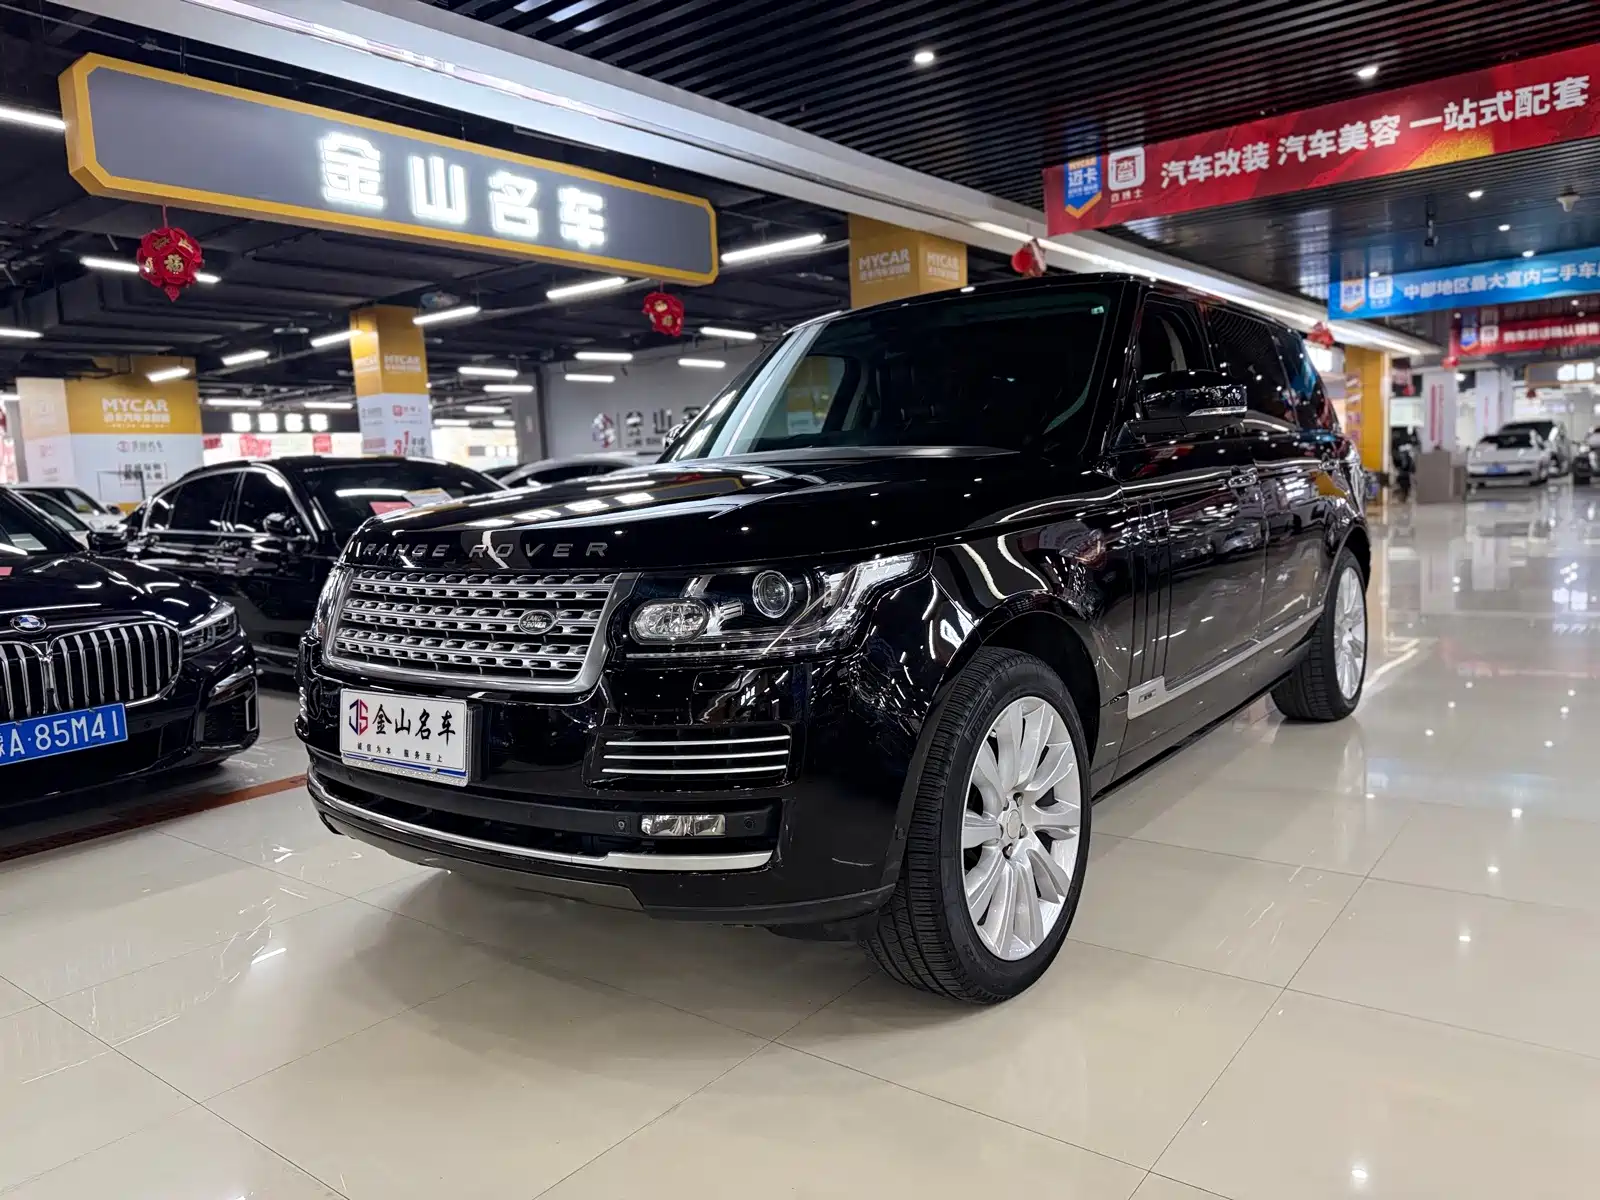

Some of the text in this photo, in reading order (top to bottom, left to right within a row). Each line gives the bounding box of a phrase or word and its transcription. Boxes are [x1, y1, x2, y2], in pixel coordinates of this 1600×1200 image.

[1161, 142, 1270, 189] 汽车改装
[1277, 115, 1400, 165] 汽车美容
[1409, 75, 1590, 131] 一站式配套
[1068, 167, 1098, 187] 迈卡
[319, 131, 606, 248] 金山名车
[859, 248, 909, 271] MYCAR
[102, 398, 168, 412] MYCAR
[363, 542, 608, 558] RANGE ROVER
[372, 704, 456, 746] 金山名车
